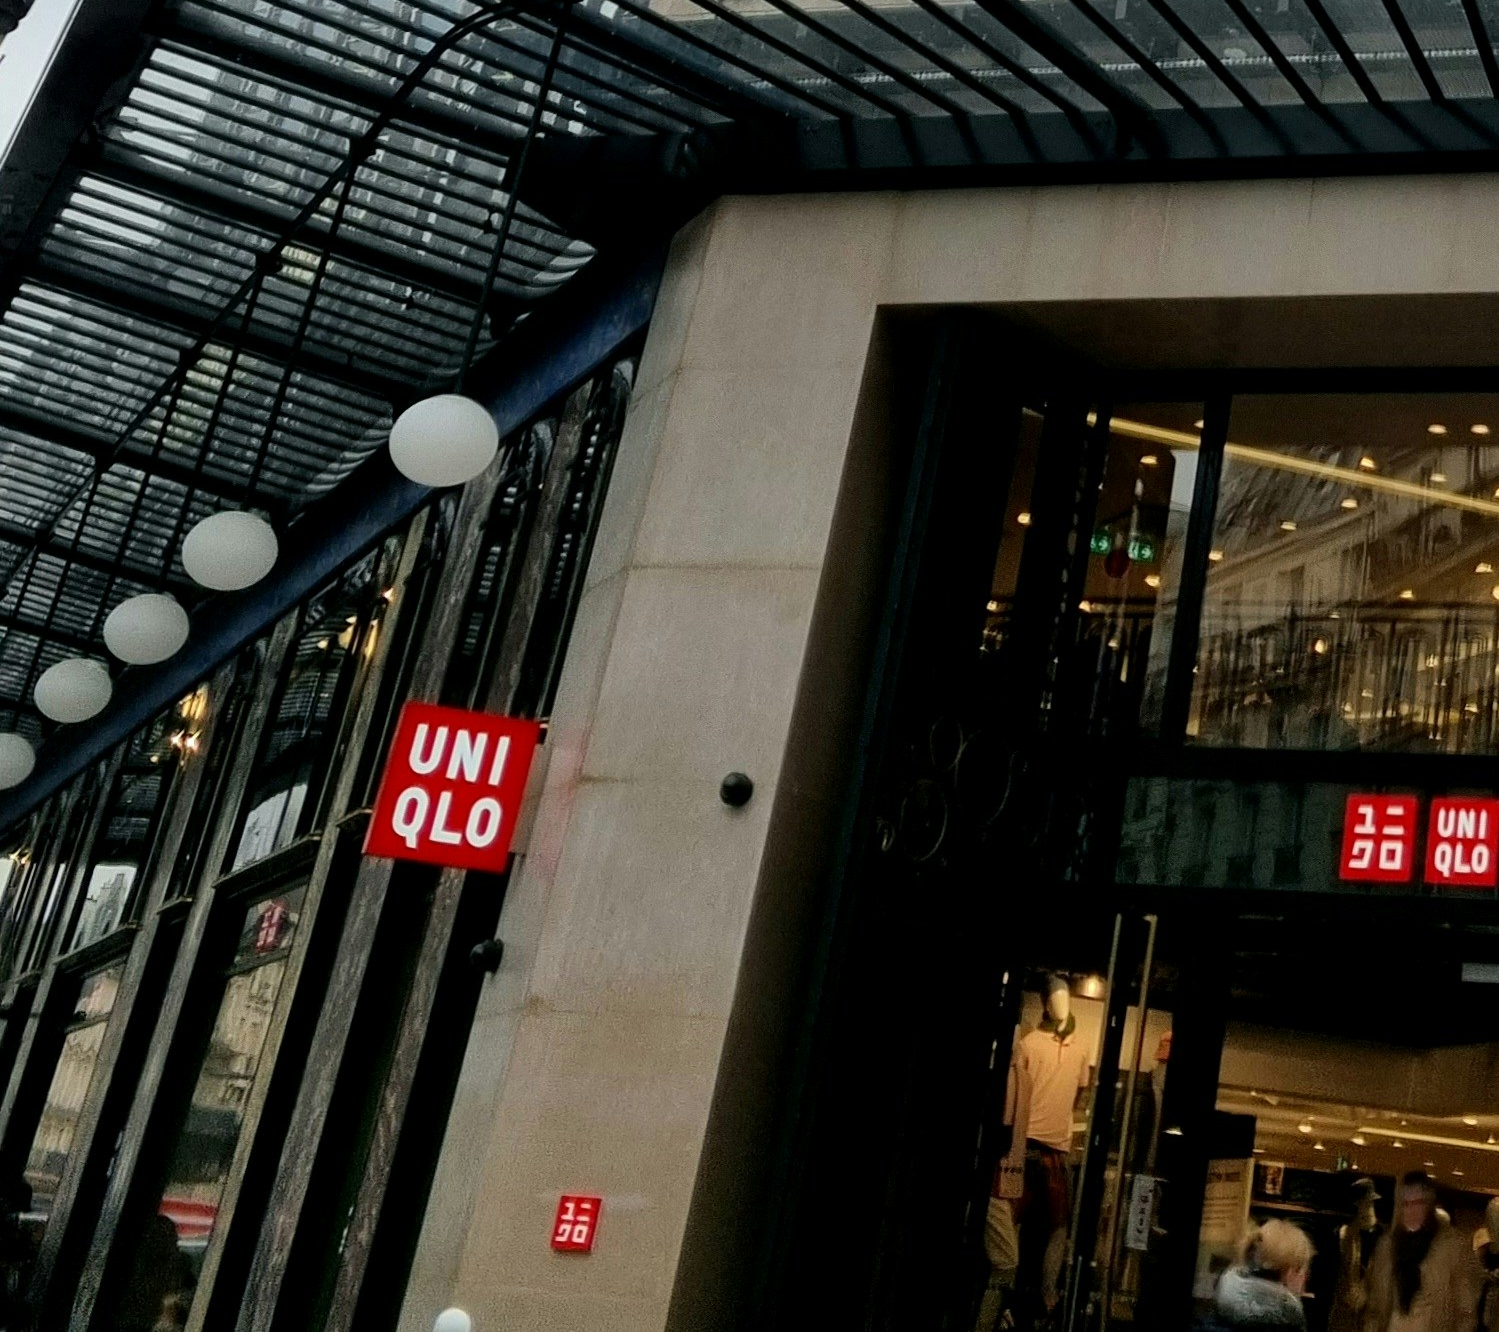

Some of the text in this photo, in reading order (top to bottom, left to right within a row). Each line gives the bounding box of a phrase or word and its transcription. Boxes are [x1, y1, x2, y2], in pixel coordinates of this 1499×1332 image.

[408, 723, 511, 786] UNI
[392, 786, 503, 849] QLO
[1354, 804, 1405, 835] ユニ
[1437, 807, 1487, 839] UNI
[1434, 841, 1489, 877] QLO
[561, 1202, 592, 1222] ユニ
